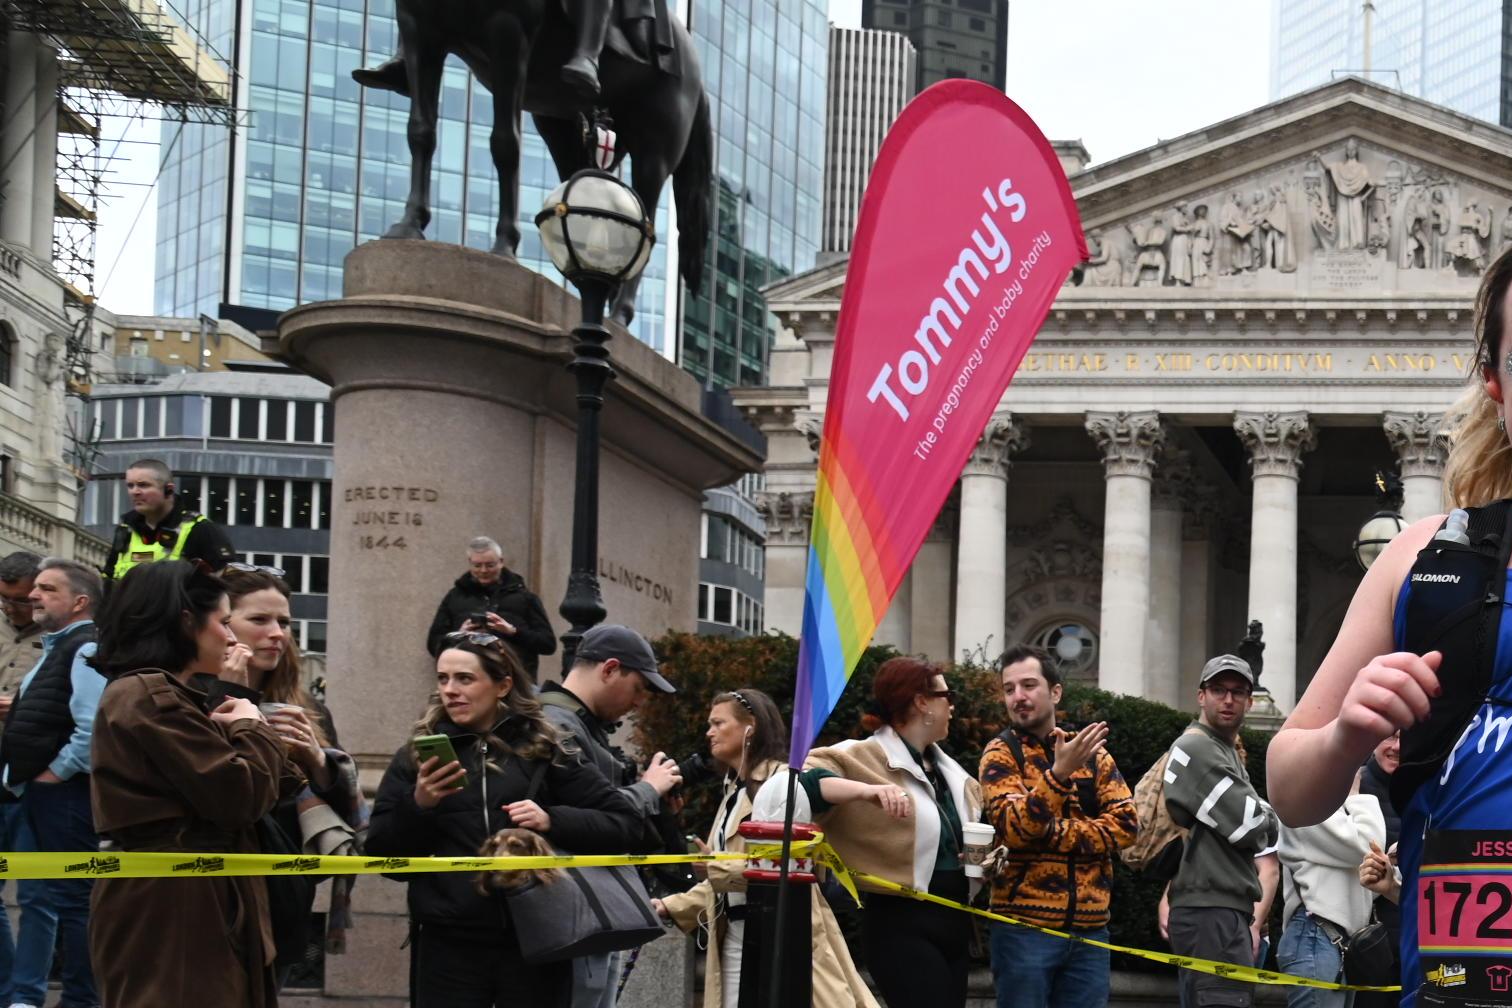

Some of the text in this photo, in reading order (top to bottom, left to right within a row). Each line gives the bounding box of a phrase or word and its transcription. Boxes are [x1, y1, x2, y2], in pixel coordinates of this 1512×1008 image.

[866, 178, 1027, 422] Tommy's
[913, 230, 1052, 461] The pregnancy and baby charity
[1154, 353, 1194, 371] XIII
[1204, 353, 1334, 371] CONDITVM
[1363, 353, 1437, 371] ANNO
[344, 486, 439, 503] ERECTED
[352, 511, 401, 526] JUNE
[359, 535, 408, 550] 1844
[599, 557, 673, 606] LLINGTON
